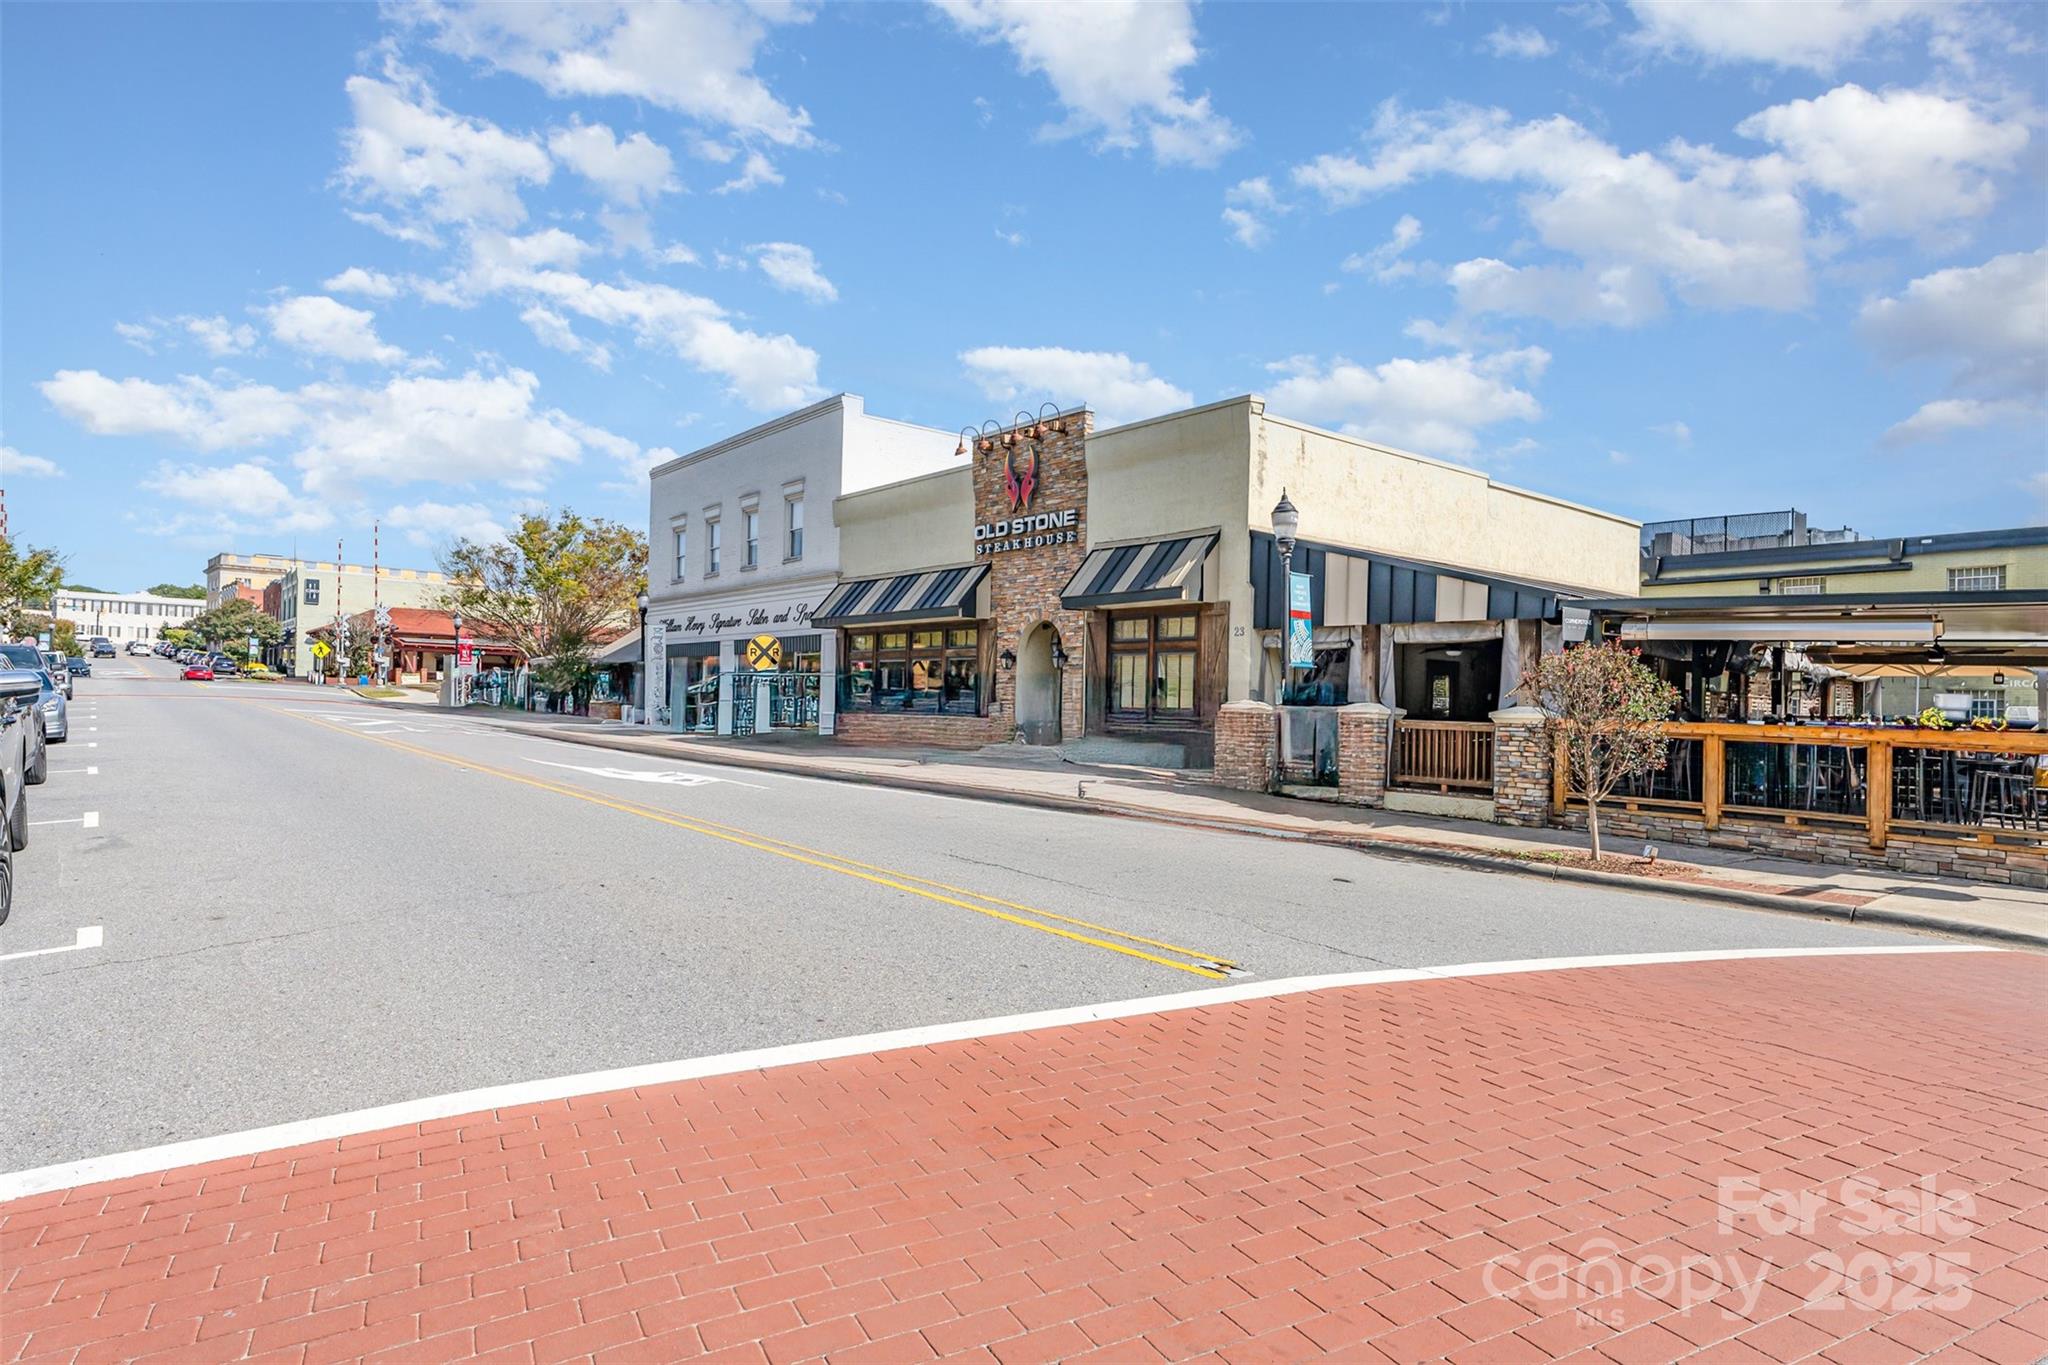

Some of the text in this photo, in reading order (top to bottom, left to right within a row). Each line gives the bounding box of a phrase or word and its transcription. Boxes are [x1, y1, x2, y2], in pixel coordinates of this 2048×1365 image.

[974, 509, 1077, 540] OLD STONE
[976, 530, 1077, 555] STEAKHOUSE
[685, 616, 705, 635] Henry
[709, 612, 742, 634] Signature
[746, 608, 769, 626] Salon
[772, 606, 791, 623] and
[1234, 626, 1245, 637] 23
